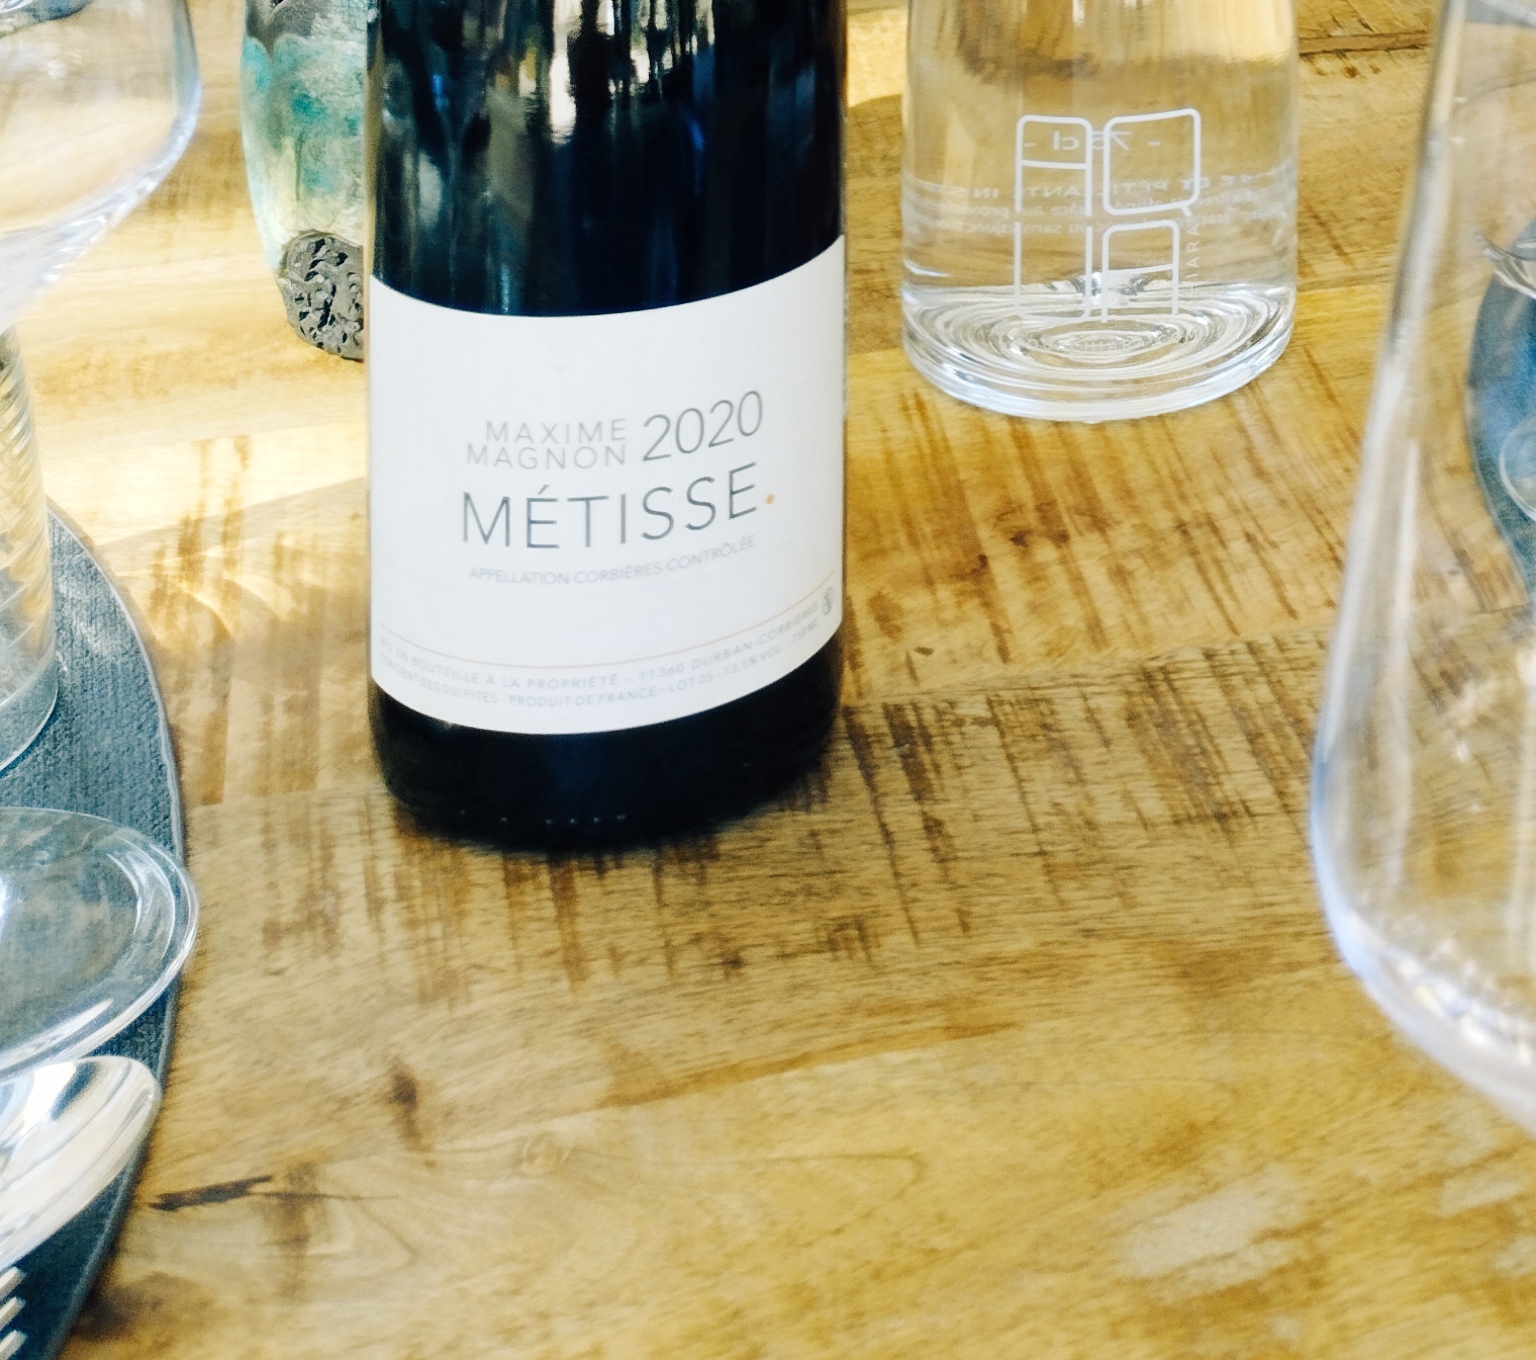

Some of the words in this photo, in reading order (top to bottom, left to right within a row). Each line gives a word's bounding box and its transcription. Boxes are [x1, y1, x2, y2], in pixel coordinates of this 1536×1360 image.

[485, 417, 627, 445] MAXIME
[642, 390, 763, 462] 2020
[466, 443, 627, 471] MAGNON
[468, 566, 570, 585] APPELLATION
[574, 560, 663, 585] CORBIÈRES
[665, 534, 757, 572] CONTRÔLÉE
